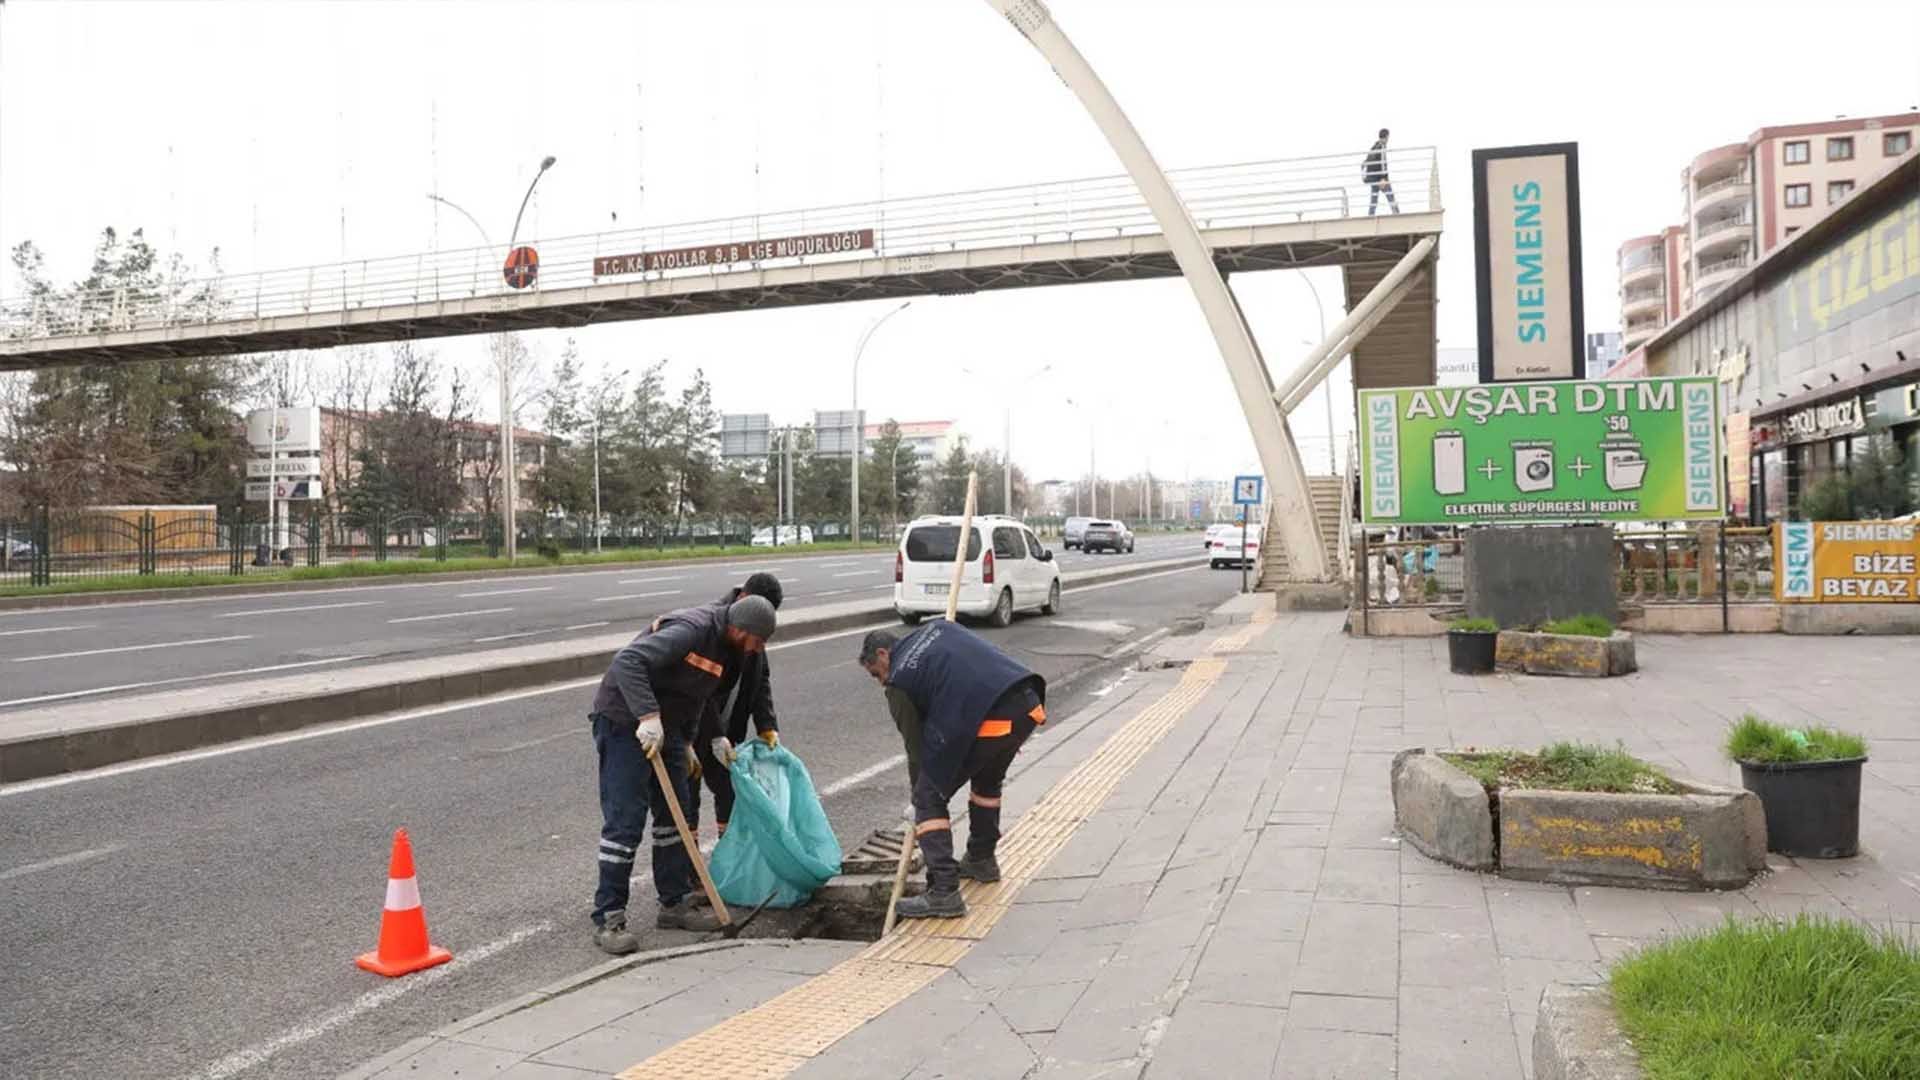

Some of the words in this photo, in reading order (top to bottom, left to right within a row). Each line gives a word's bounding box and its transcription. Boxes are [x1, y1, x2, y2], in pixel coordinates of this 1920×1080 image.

[776, 231, 861, 257] MÜDÜRLÜĞÜ
[1513, 181, 1546, 342] SIEMENS
[1406, 386, 1558, 425] AVŞAR
[1574, 381, 1676, 413] DTM
[1374, 399, 1396, 512] SIEMENS
[1688, 388, 1714, 505] SIEMENS
[1445, 501, 1505, 516] ELEKTRİK
[1509, 500, 1586, 513] SÜPÜRGESİ
[1590, 499, 1639, 512] HEDİYE
[1823, 524, 1914, 541] SIEMENS
[1854, 551, 1915, 573] BİZE
[1823, 578, 1908, 597] BEYAZ
